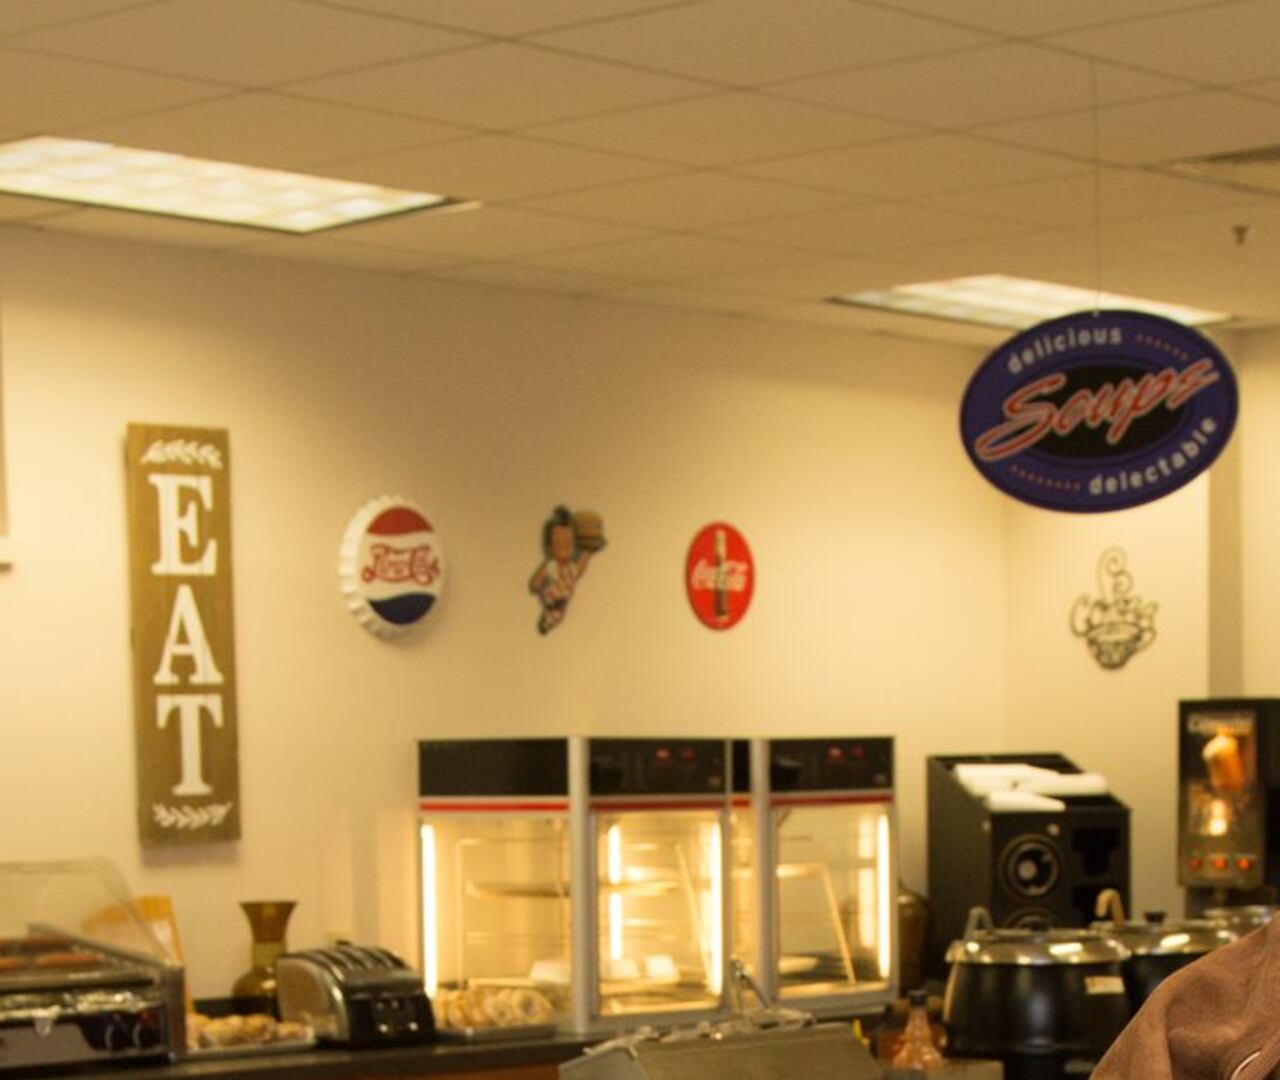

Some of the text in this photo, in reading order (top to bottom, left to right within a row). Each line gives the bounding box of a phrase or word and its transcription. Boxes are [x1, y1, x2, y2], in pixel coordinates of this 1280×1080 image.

[1007, 326, 1122, 374] delicious
[975, 357, 1219, 461] Soups
[1088, 417, 1217, 496] delectable
[147, 472, 225, 797] EAT
